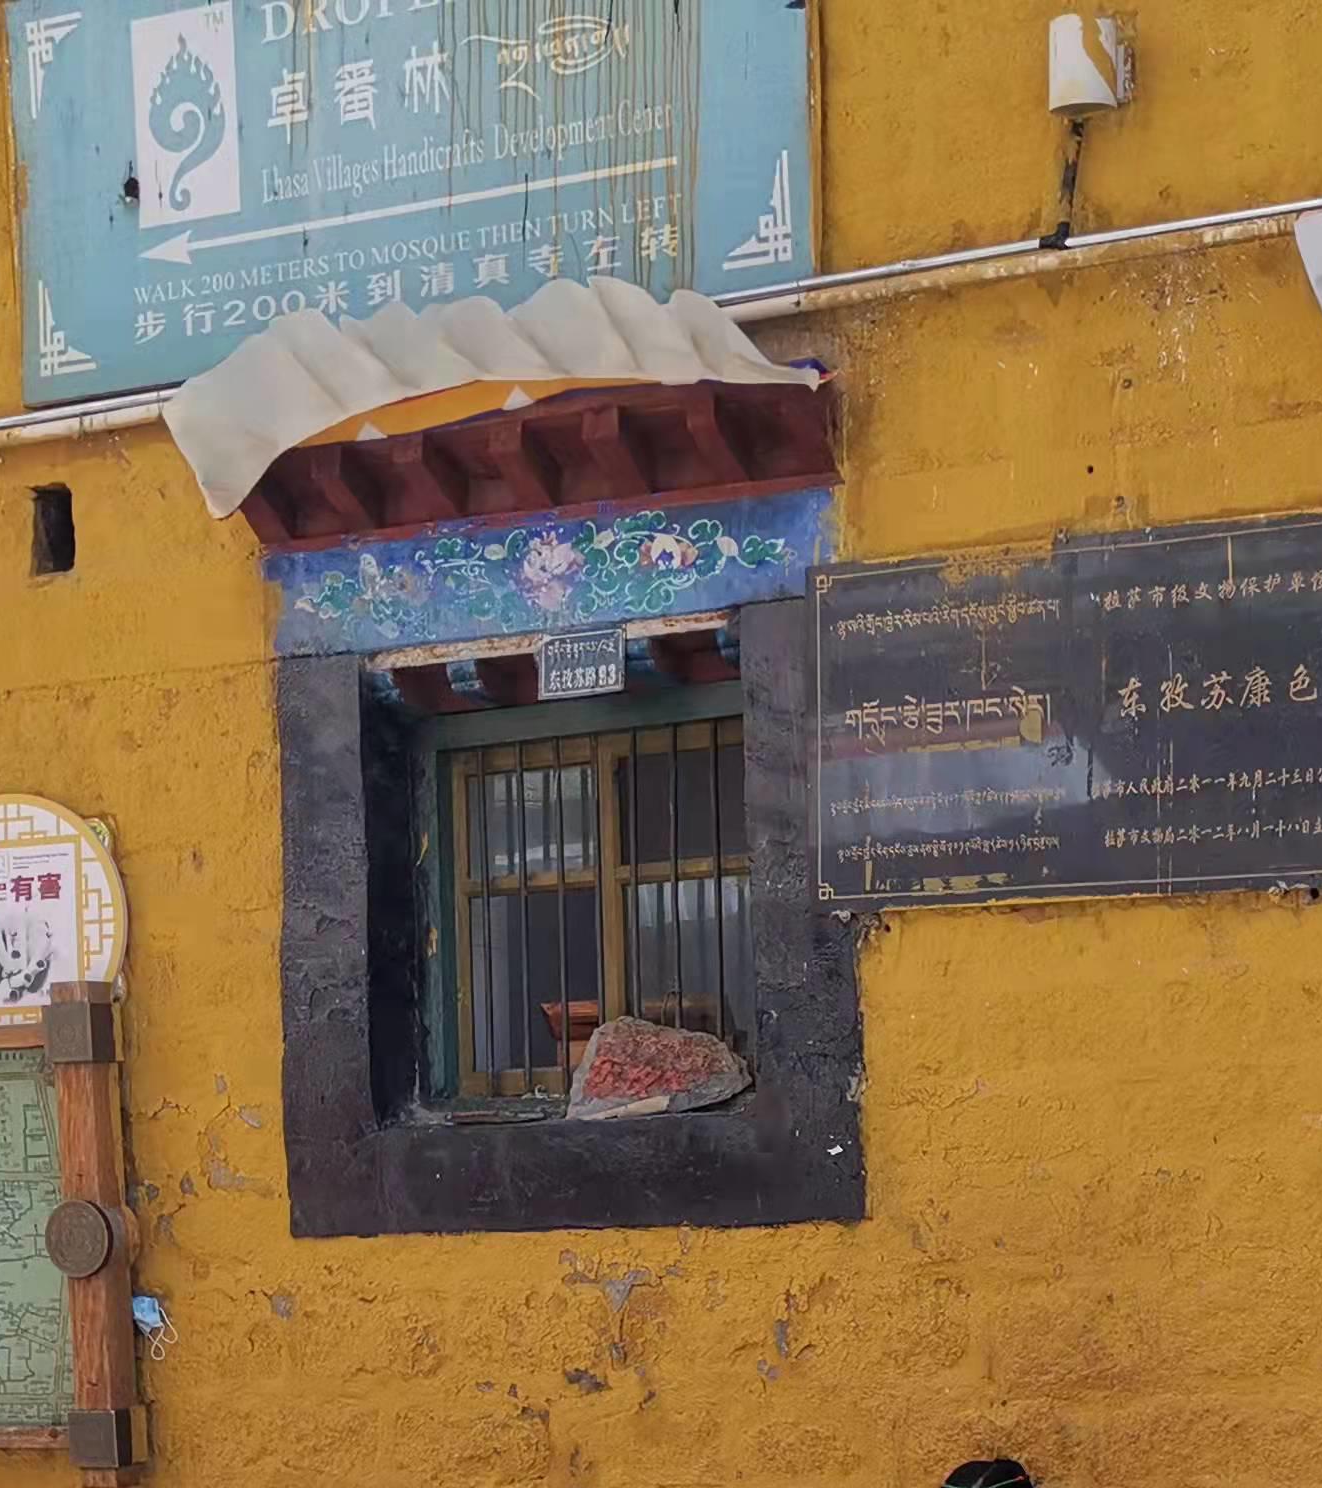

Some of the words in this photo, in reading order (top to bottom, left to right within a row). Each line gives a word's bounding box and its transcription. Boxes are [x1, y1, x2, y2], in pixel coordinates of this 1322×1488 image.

[261, 166, 309, 204] Lhasa
[312, 154, 378, 198] Villages
[383, 129, 484, 181] Handicrafts
[134, 278, 195, 304] WALK
[201, 272, 235, 294] 200
[241, 254, 329, 289] METERS
[336, 249, 365, 271] TO
[371, 229, 470, 265] MOSQUE
[477, 219, 541, 249] THEN
[543, 206, 614, 236] TURN
[621, 193, 682, 224] LEFT
[1118, 663, 1318, 717] 东孜苏康色
[10, 872, 62, 902] 有害
